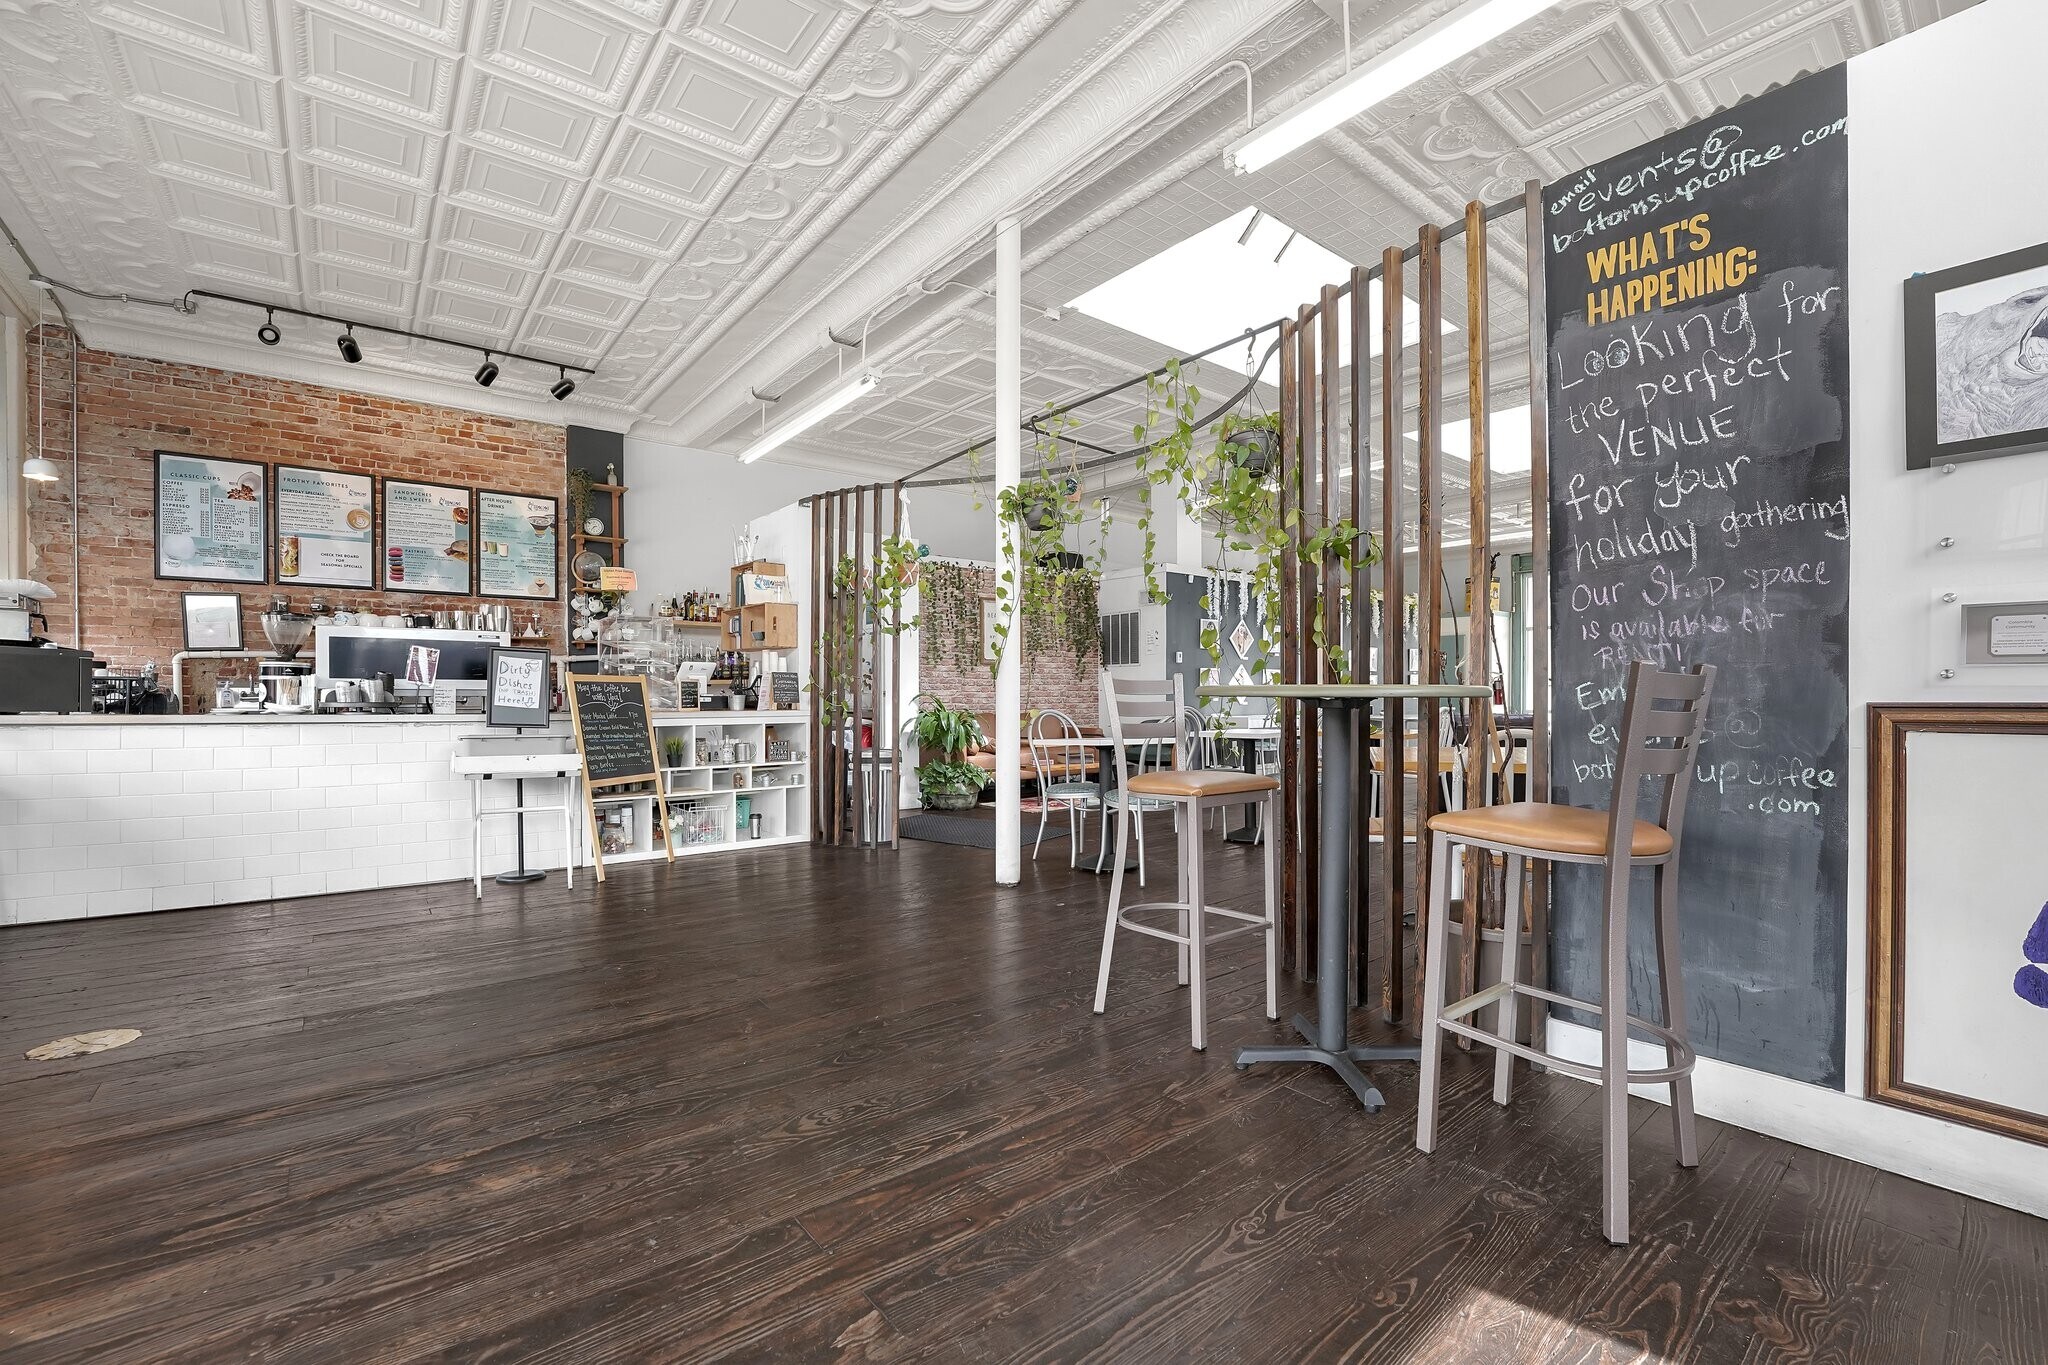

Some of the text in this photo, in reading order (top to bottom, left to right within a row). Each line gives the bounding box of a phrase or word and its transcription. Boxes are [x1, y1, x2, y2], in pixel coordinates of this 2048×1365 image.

[1578, 125, 1742, 212] events@
[1586, 213, 1711, 284] WHAT'S
[1587, 246, 1758, 327] HAPPENING:
[1777, 280, 1840, 324] for
[1564, 337, 1793, 435] the perfect
[1597, 404, 1738, 466] VENUE
[312, 481, 349, 489] FAVORITES
[393, 489, 432, 498] SANDWICHES
[1565, 454, 1751, 521] for your
[1573, 494, 1850, 577] holiday gathering
[1744, 561, 1831, 603] space
[1580, 615, 1600, 641] is
[499, 676, 533, 690] Dishes
[500, 660, 531, 679] Dirty
[577, 684, 591, 696] May
[498, 695, 525, 705] Here!
[1748, 796, 1820, 816] .com
